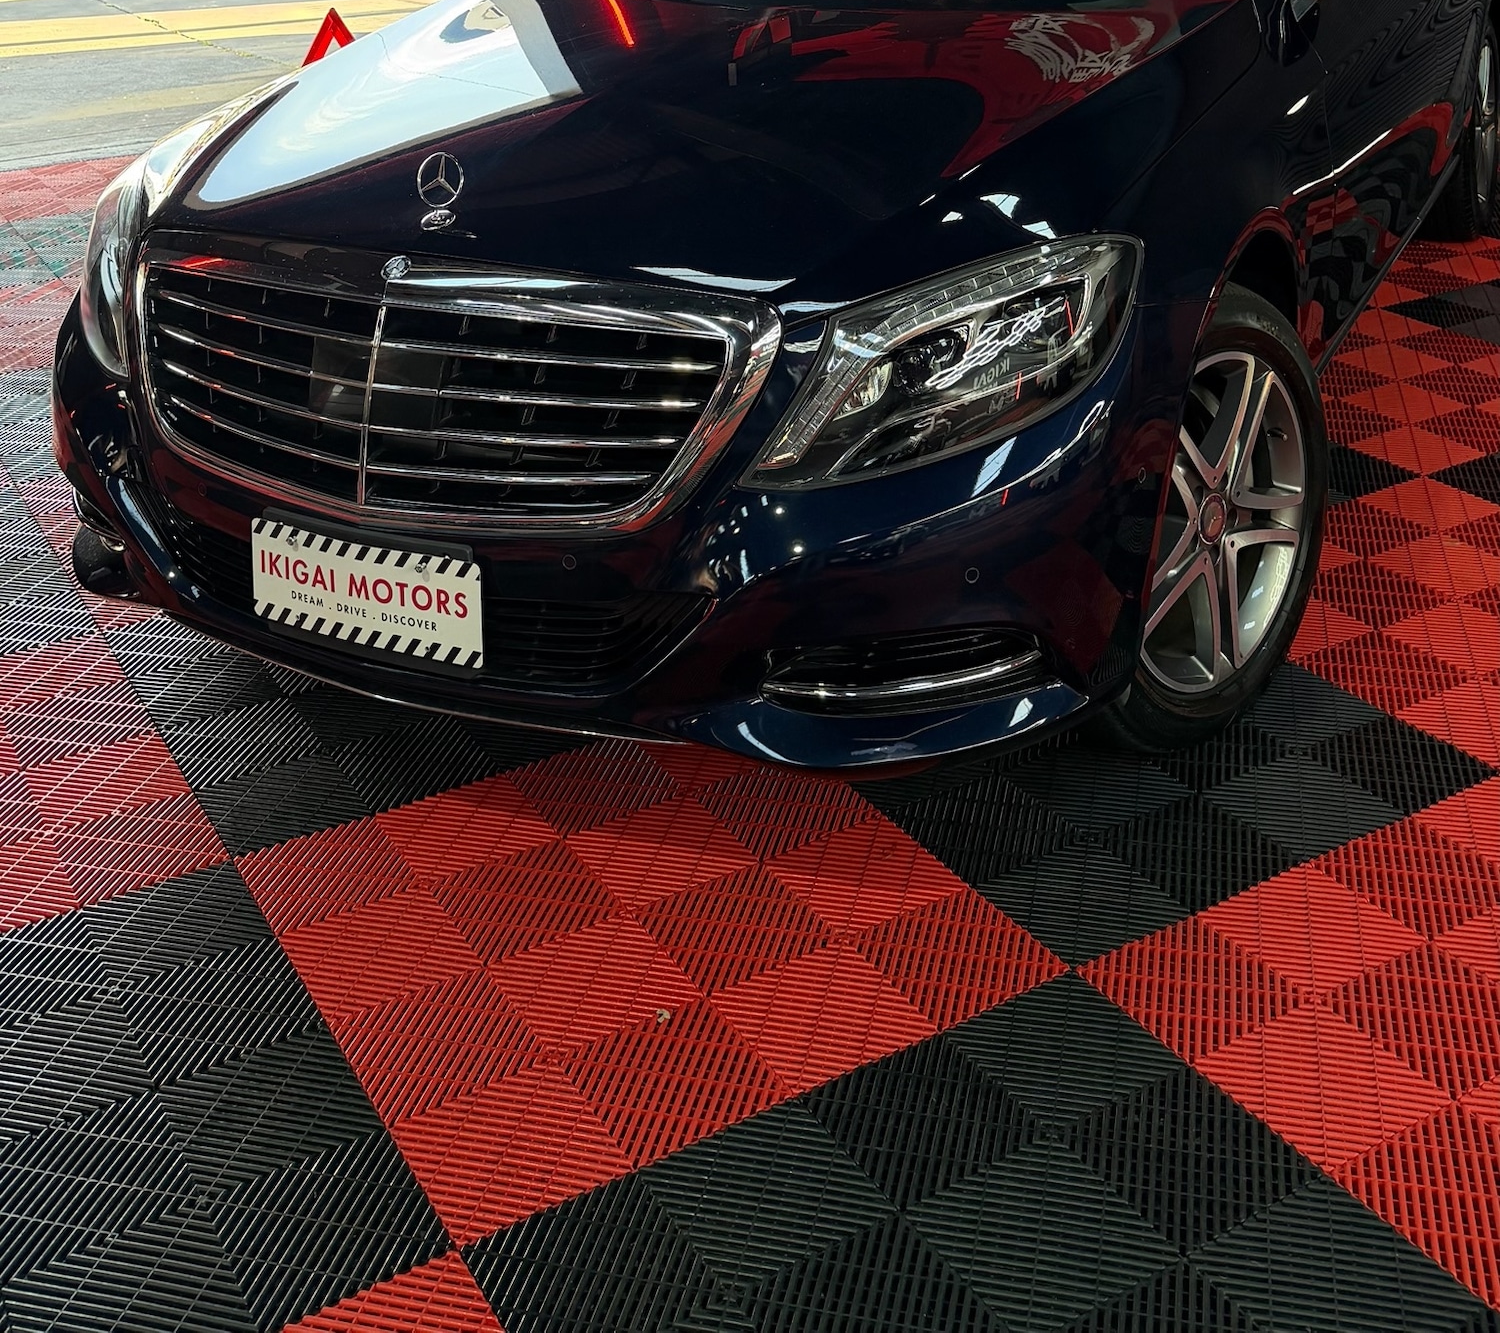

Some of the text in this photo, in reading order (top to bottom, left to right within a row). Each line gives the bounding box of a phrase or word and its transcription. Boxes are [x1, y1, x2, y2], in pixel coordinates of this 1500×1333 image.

[259, 549, 469, 619] IKIGAI MOTORS
[291, 590, 325, 608] DREAM
[336, 602, 368, 618] DRIVE
[381, 613, 437, 632] DISCOVER
